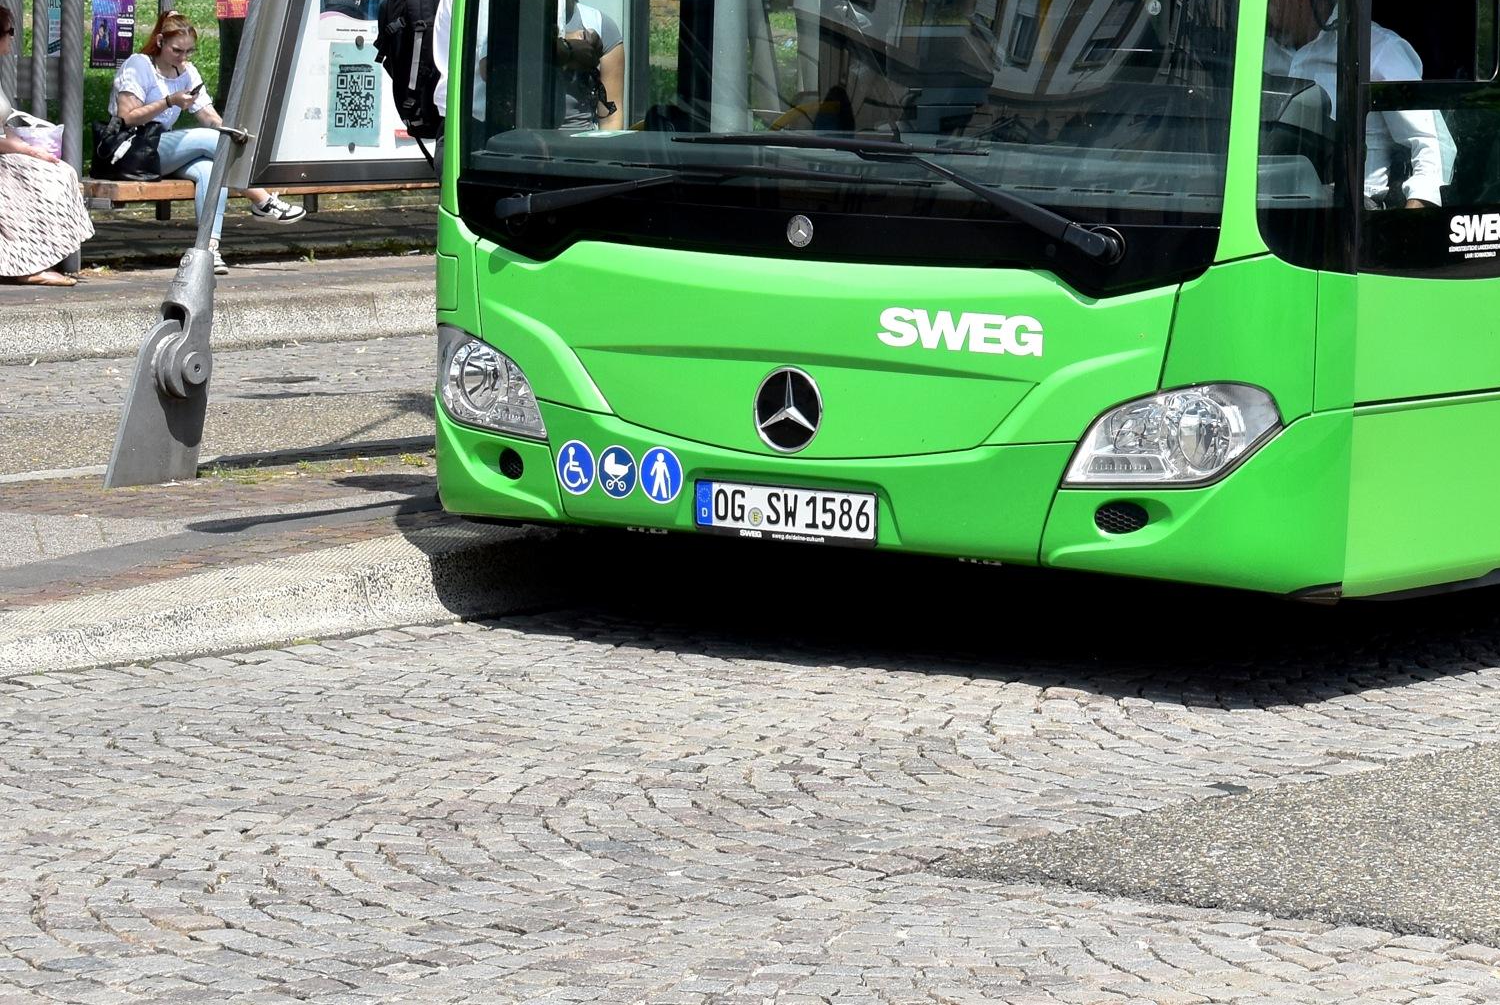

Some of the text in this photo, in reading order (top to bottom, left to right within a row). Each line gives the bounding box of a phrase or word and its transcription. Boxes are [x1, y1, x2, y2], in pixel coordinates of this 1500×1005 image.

[876, 307, 1044, 357] SWEG
[701, 488, 870, 532] D OG SW 1586
[739, 529, 762, 538] SWEG
